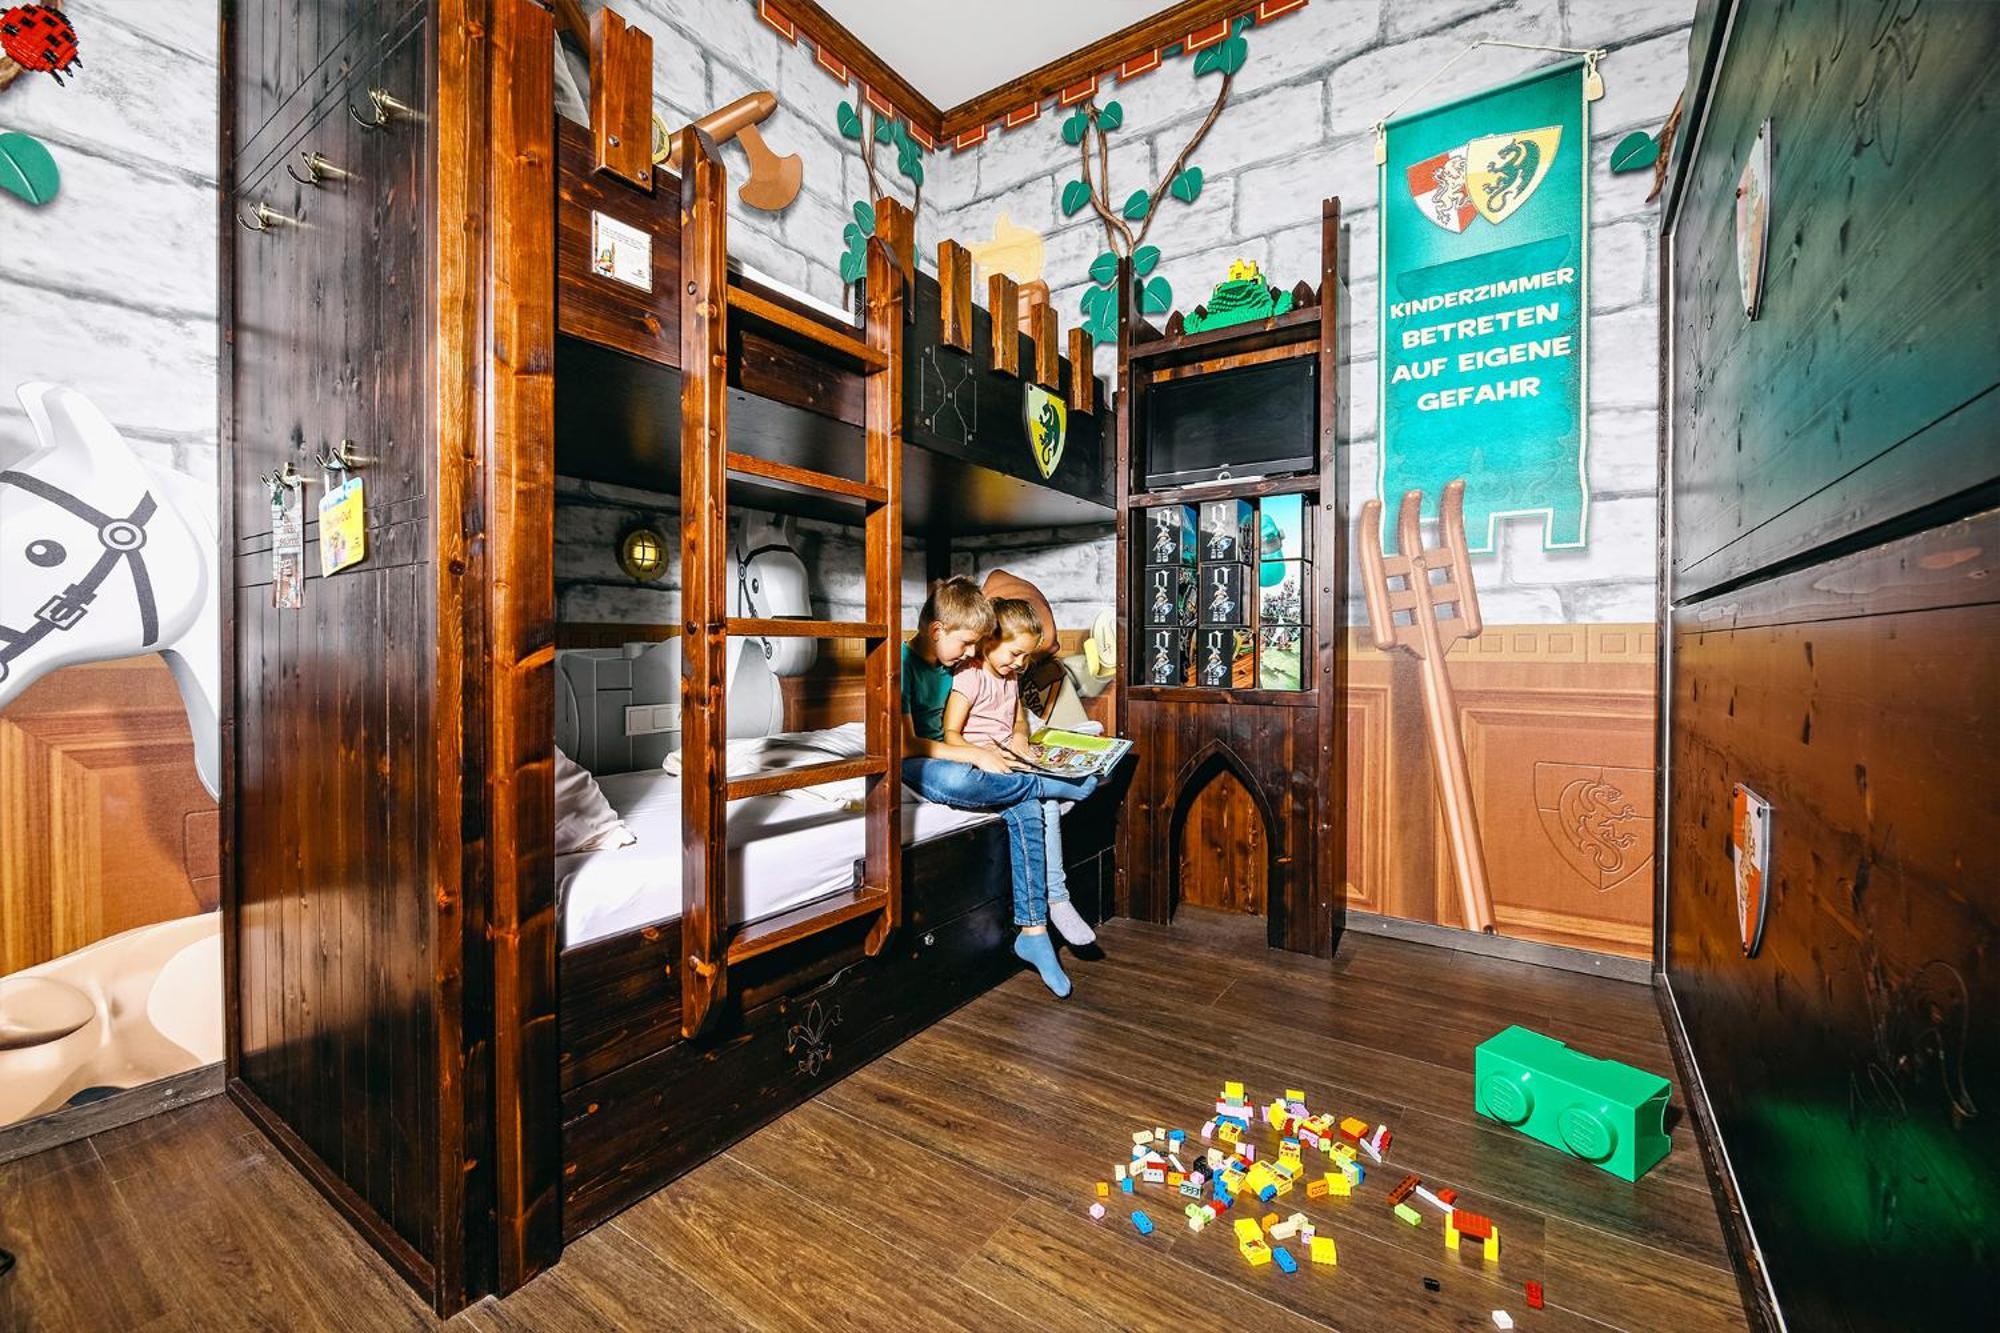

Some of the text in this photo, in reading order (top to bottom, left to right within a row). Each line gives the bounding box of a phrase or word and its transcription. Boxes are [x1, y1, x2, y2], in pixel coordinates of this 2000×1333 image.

[1390, 267, 1575, 319] KINDERZIMMER
[1402, 302, 1559, 349] BETRETEN
[1391, 335, 1572, 384] AUF EIGENE
[1416, 376, 1541, 411] GEFAHR
